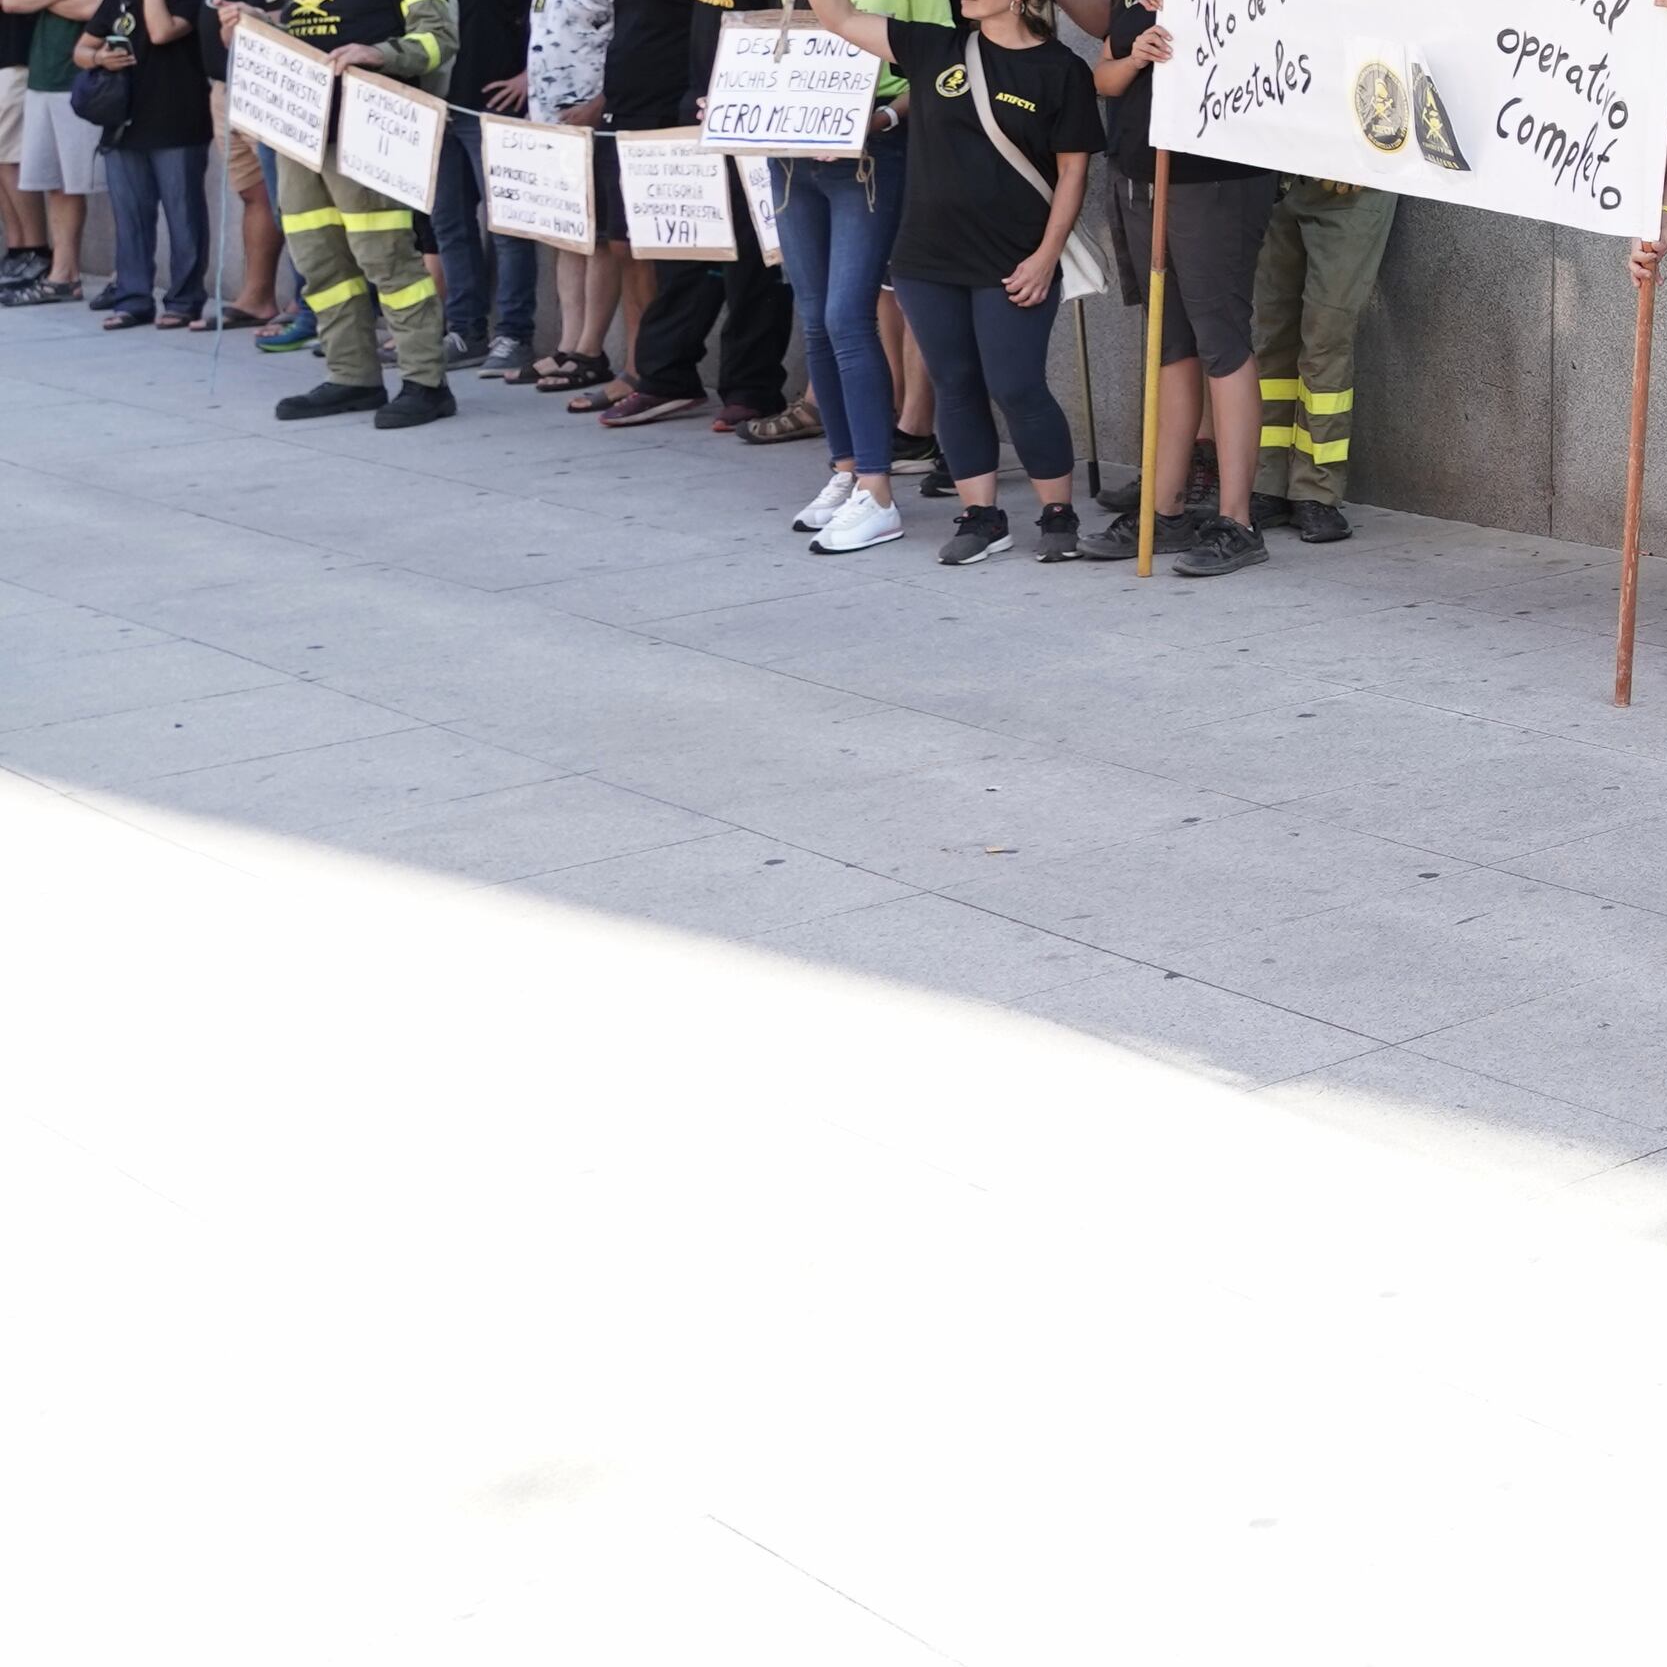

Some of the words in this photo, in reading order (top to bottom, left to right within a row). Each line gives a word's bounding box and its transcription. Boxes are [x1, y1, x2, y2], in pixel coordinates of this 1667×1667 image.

[804, 37, 862, 58] JUNIO
[716, 70, 778, 90] MUCHAS
[788, 70, 875, 91] PALABRAS
[1496, 27, 1629, 131] operativo
[707, 104, 762, 135] CERO
[766, 105, 861, 136] MEJORAS
